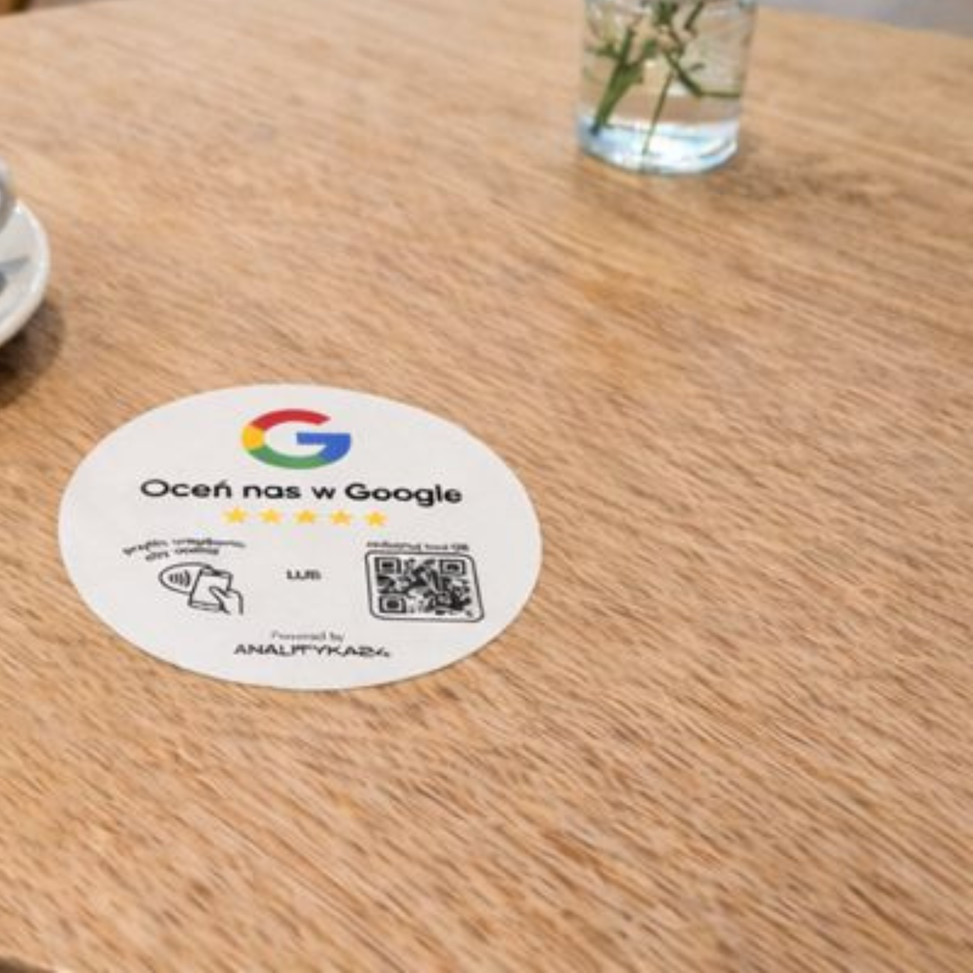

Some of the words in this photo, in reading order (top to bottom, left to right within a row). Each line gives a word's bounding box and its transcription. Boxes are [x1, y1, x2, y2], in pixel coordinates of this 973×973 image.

[140, 479, 232, 498] Oceń
[243, 485, 302, 499] nas
[311, 486, 336, 499] w
[344, 483, 462, 508] Google
[329, 632, 344, 643] by
